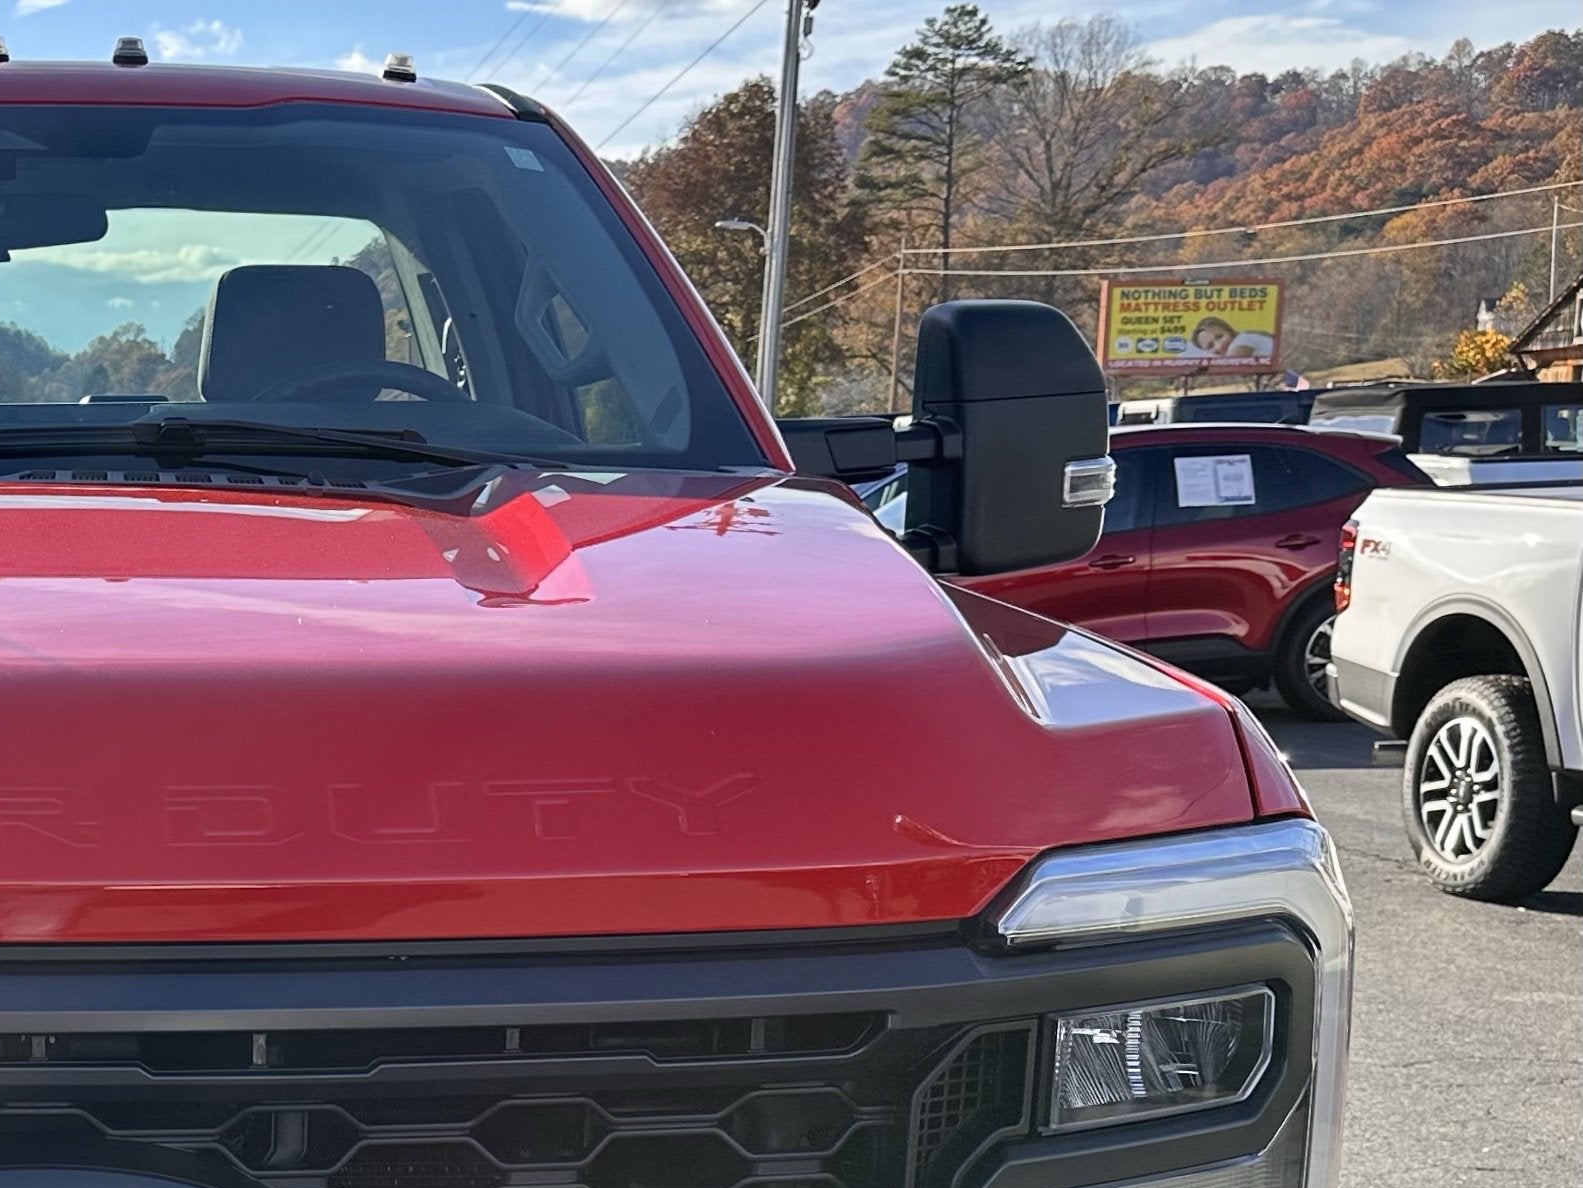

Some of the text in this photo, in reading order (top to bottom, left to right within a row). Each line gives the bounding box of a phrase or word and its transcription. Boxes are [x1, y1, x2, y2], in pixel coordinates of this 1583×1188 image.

[1120, 287, 1268, 300] NOTHING BUT BEDS
[1119, 300, 1266, 313] MATTRESS OUTLET
[1121, 315, 1182, 325] QUEEN SET
[1360, 539, 1392, 556] FX4
[162, 772, 756, 848] DUTY
